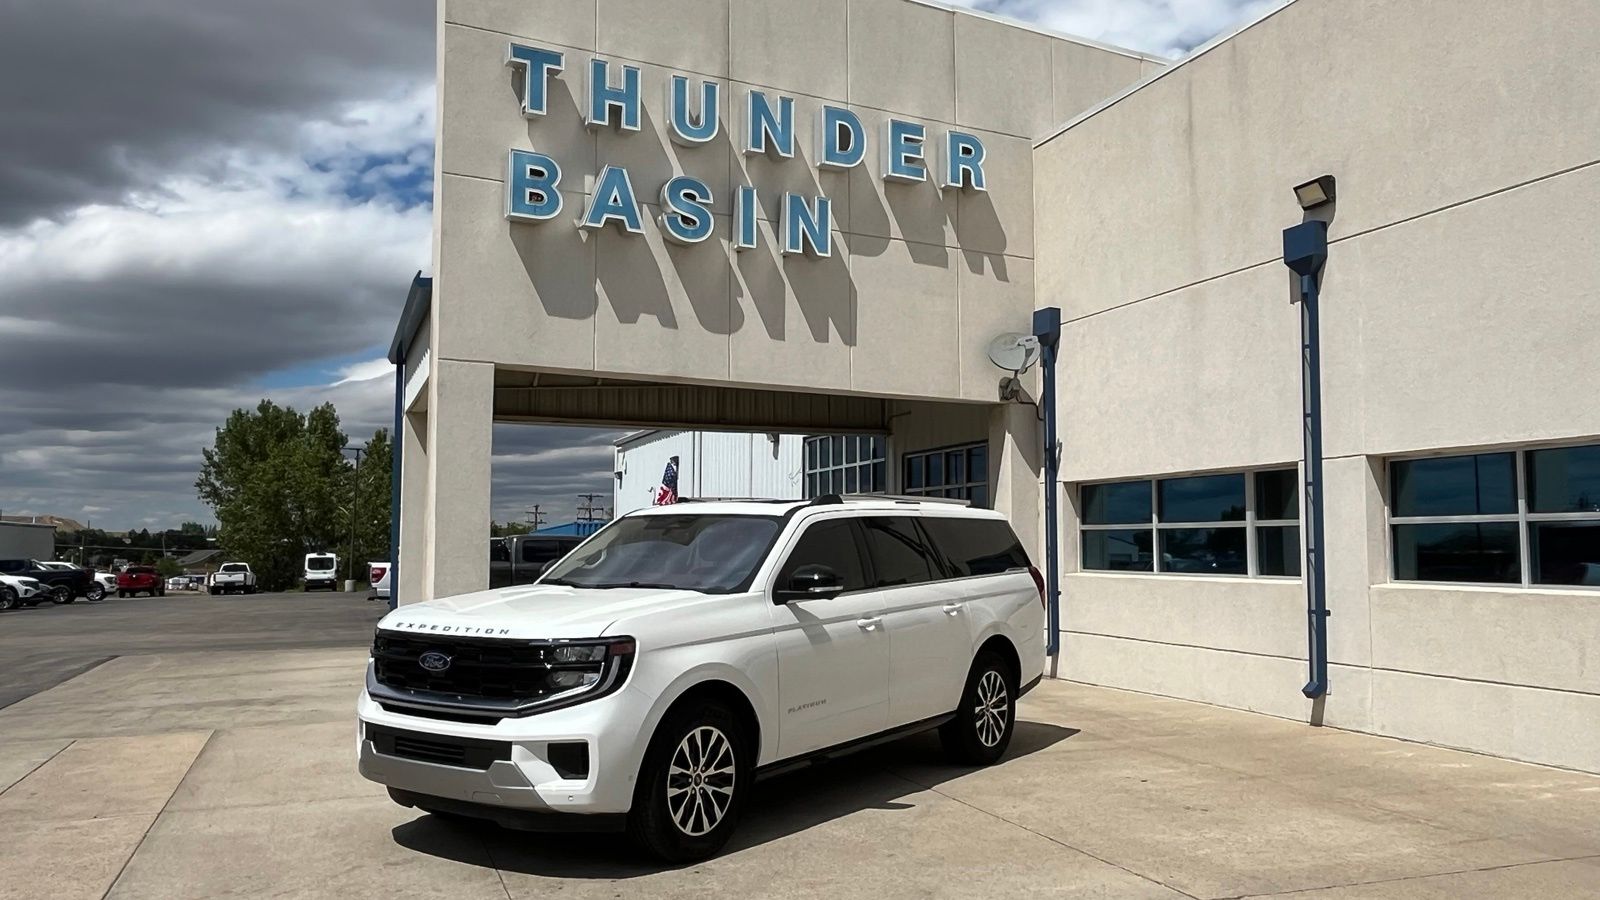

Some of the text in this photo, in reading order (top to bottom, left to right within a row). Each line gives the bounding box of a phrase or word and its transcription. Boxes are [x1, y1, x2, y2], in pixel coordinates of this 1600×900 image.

[508, 43, 987, 193] THUNDER
[506, 149, 833, 258] BASIN
[396, 622, 510, 635] EXPEDITION
[422, 653, 447, 669] Ford
